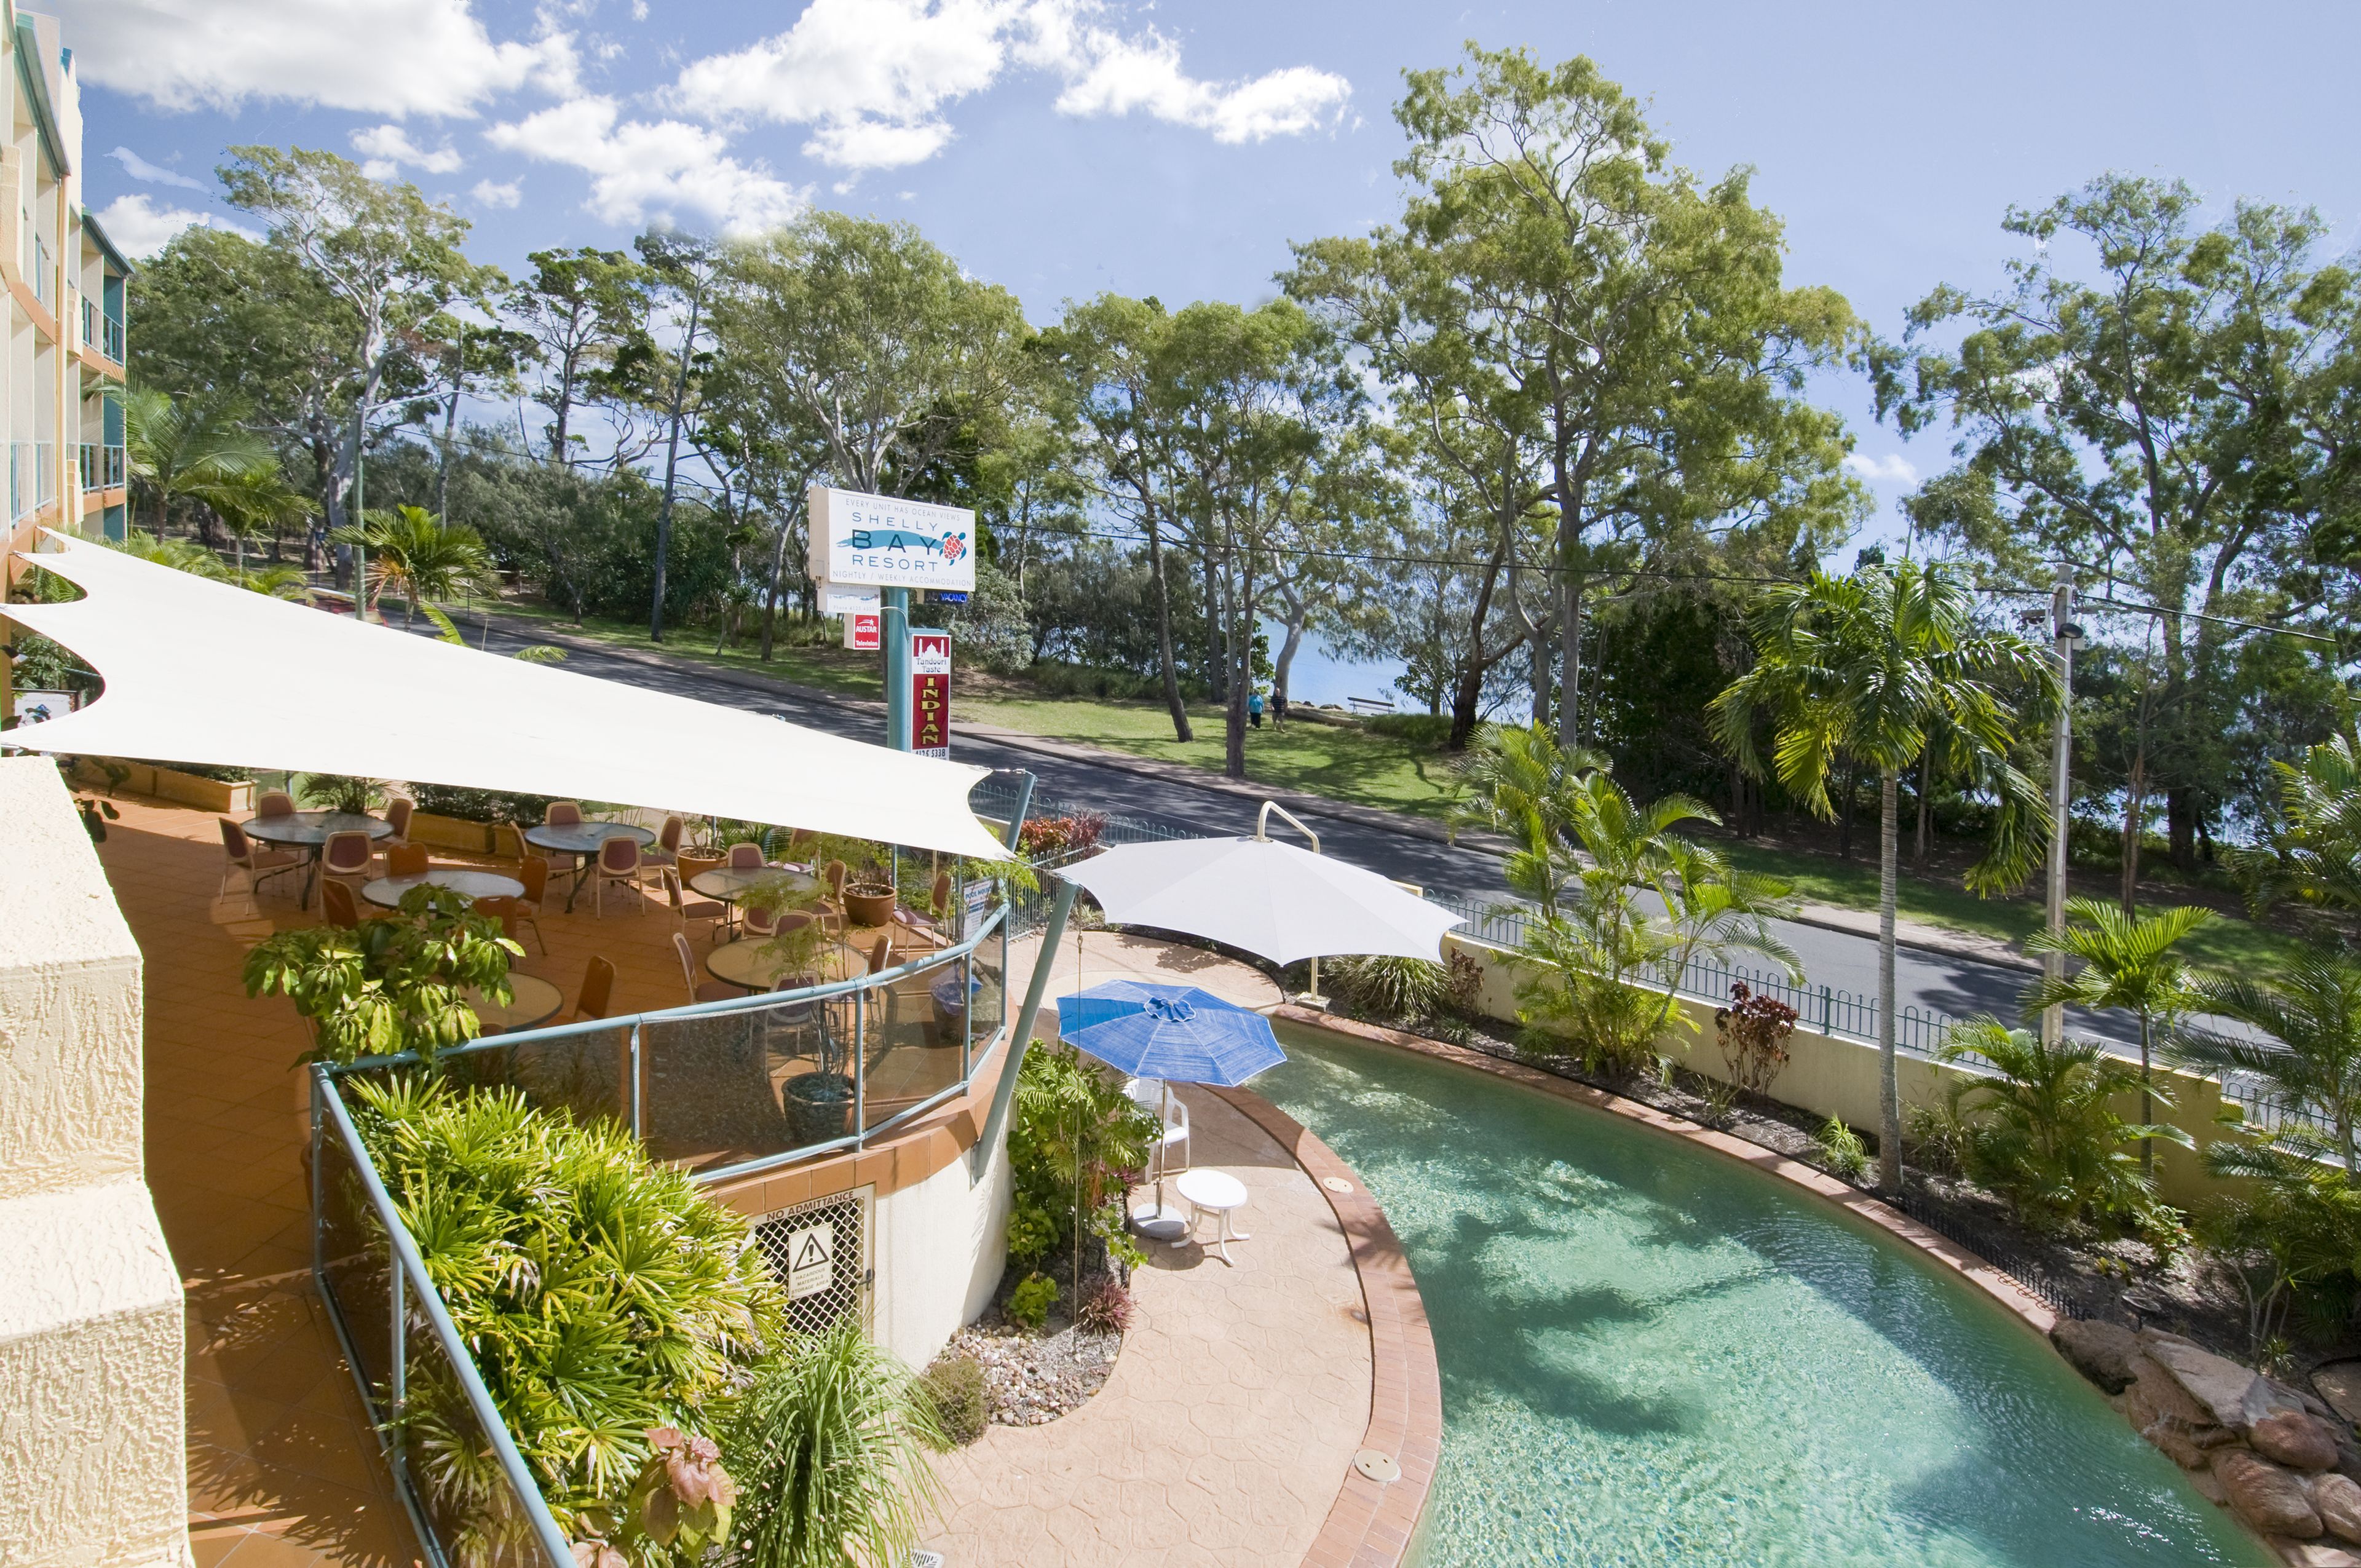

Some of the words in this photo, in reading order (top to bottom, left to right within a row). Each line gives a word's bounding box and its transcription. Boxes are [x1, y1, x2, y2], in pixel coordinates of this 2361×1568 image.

[845, 498, 869, 509] EVERY
[873, 502, 891, 512] UNIT
[911, 509, 937, 518] OCEAN
[939, 513, 960, 521] VIEWS
[852, 512, 938, 531] SHELLY
[852, 529, 937, 555] BAY
[852, 555, 938, 572] RESORT
[832, 571, 866, 580] NIGHTLY
[878, 573, 906, 582] WEEKLY
[910, 576, 971, 587] ACCOMMODATION
[940, 593, 968, 603] VACANCY
[920, 677, 941, 745] INDIAN
[931, 748, 946, 758] 5338
[767, 1210, 785, 1221] NO
[788, 1191, 854, 1216] ADMITTANCE
[796, 1267, 825, 1280] HAZARDOUS
[797, 1274, 824, 1286] MATERIALS
[791, 1284, 814, 1294] STORAGE
